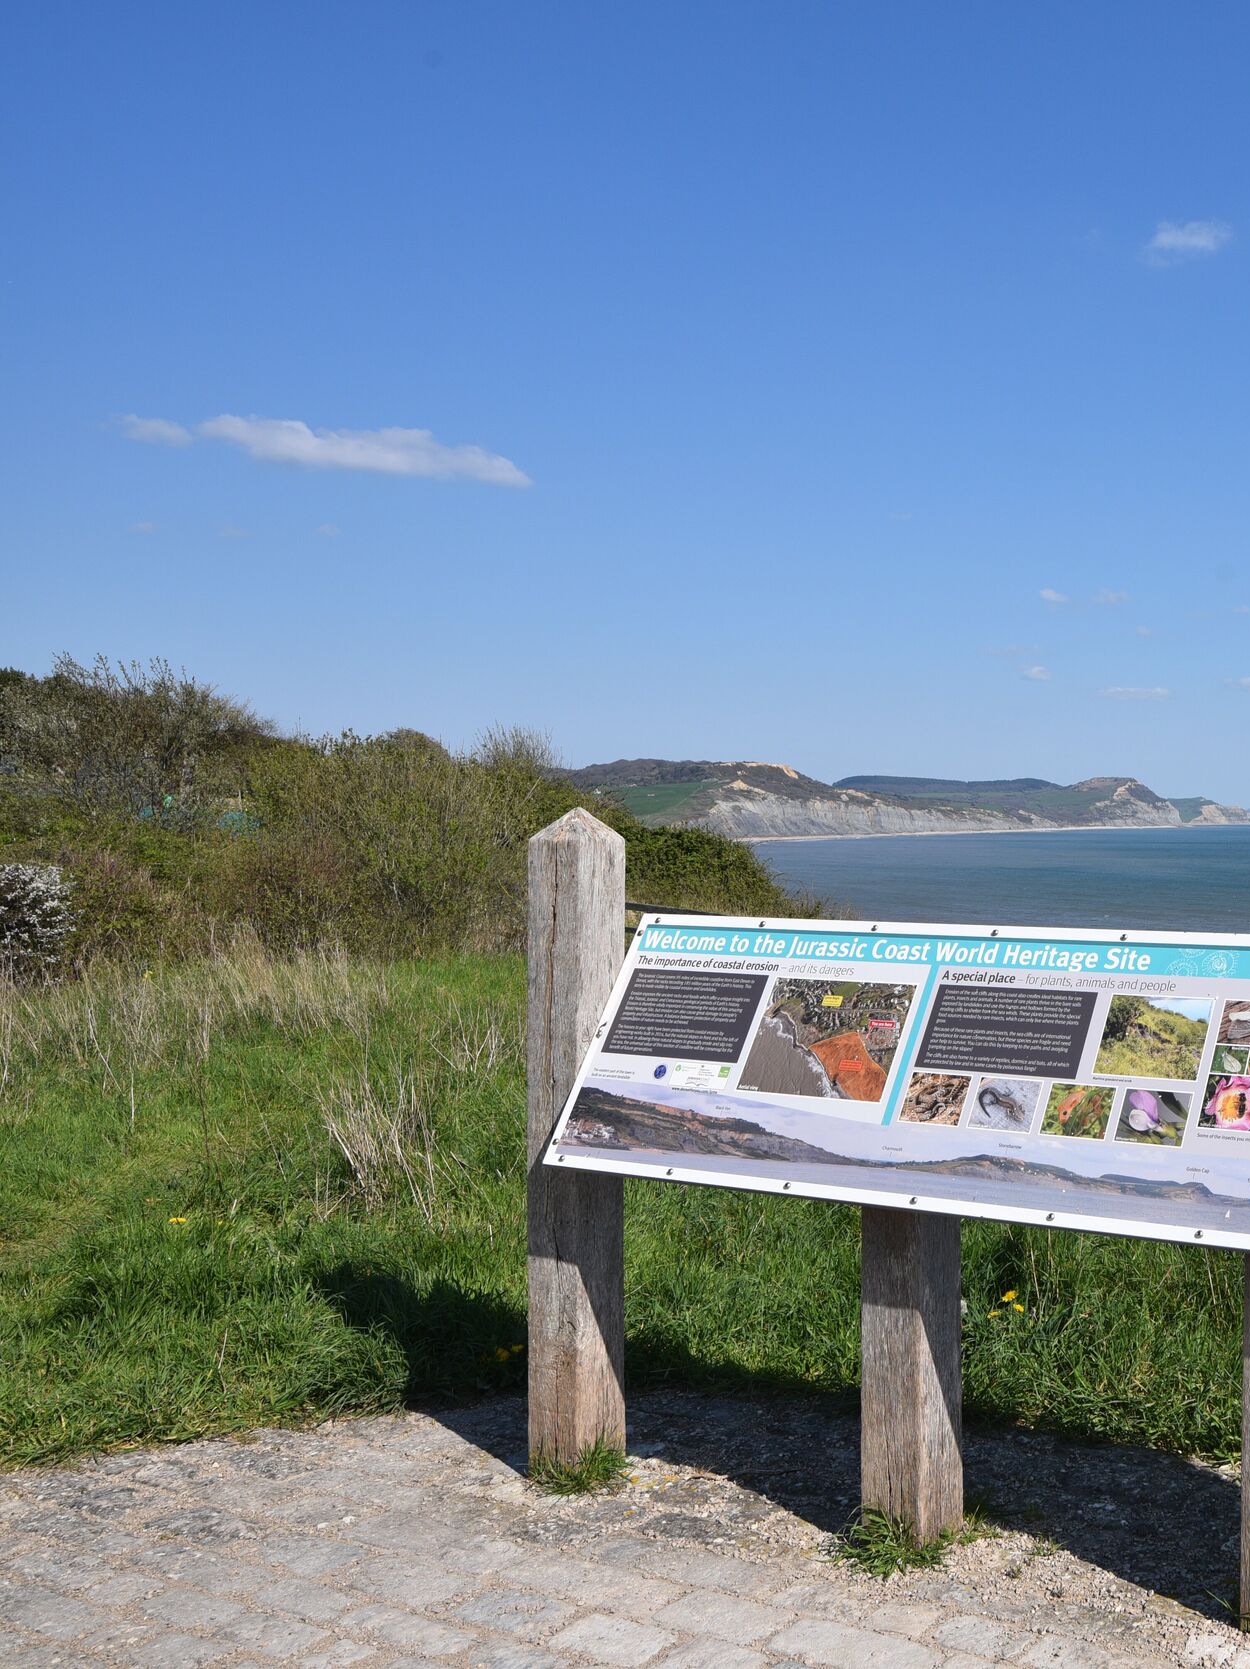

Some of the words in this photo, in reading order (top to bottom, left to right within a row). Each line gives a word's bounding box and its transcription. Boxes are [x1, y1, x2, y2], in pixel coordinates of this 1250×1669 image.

[644, 929, 723, 953] Welcome
[730, 937, 749, 954] to
[752, 934, 786, 956] the
[787, 935, 868, 963] Jurassic
[872, 939, 931, 961] Coast
[935, 941, 999, 964] World
[1002, 944, 1099, 973] Heritage
[1103, 947, 1151, 972] Site
[638, 955, 654, 966] The
[653, 955, 701, 972] importance
[702, 957, 714, 969] of
[713, 958, 746, 971] coastal
[746, 961, 780, 972] erosion
[789, 961, 806, 973] and
[807, 963, 818, 974] its
[819, 963, 855, 978] dangers
[942, 971, 951, 980] A
[952, 970, 987, 985] special
[987, 972, 1016, 986] place
[1025, 972, 1039, 985] for
[1040, 973, 1073, 989] plants,
[1075, 974, 1115, 989] animals
[1117, 976, 1138, 990] and
[1139, 978, 1177, 995] people
